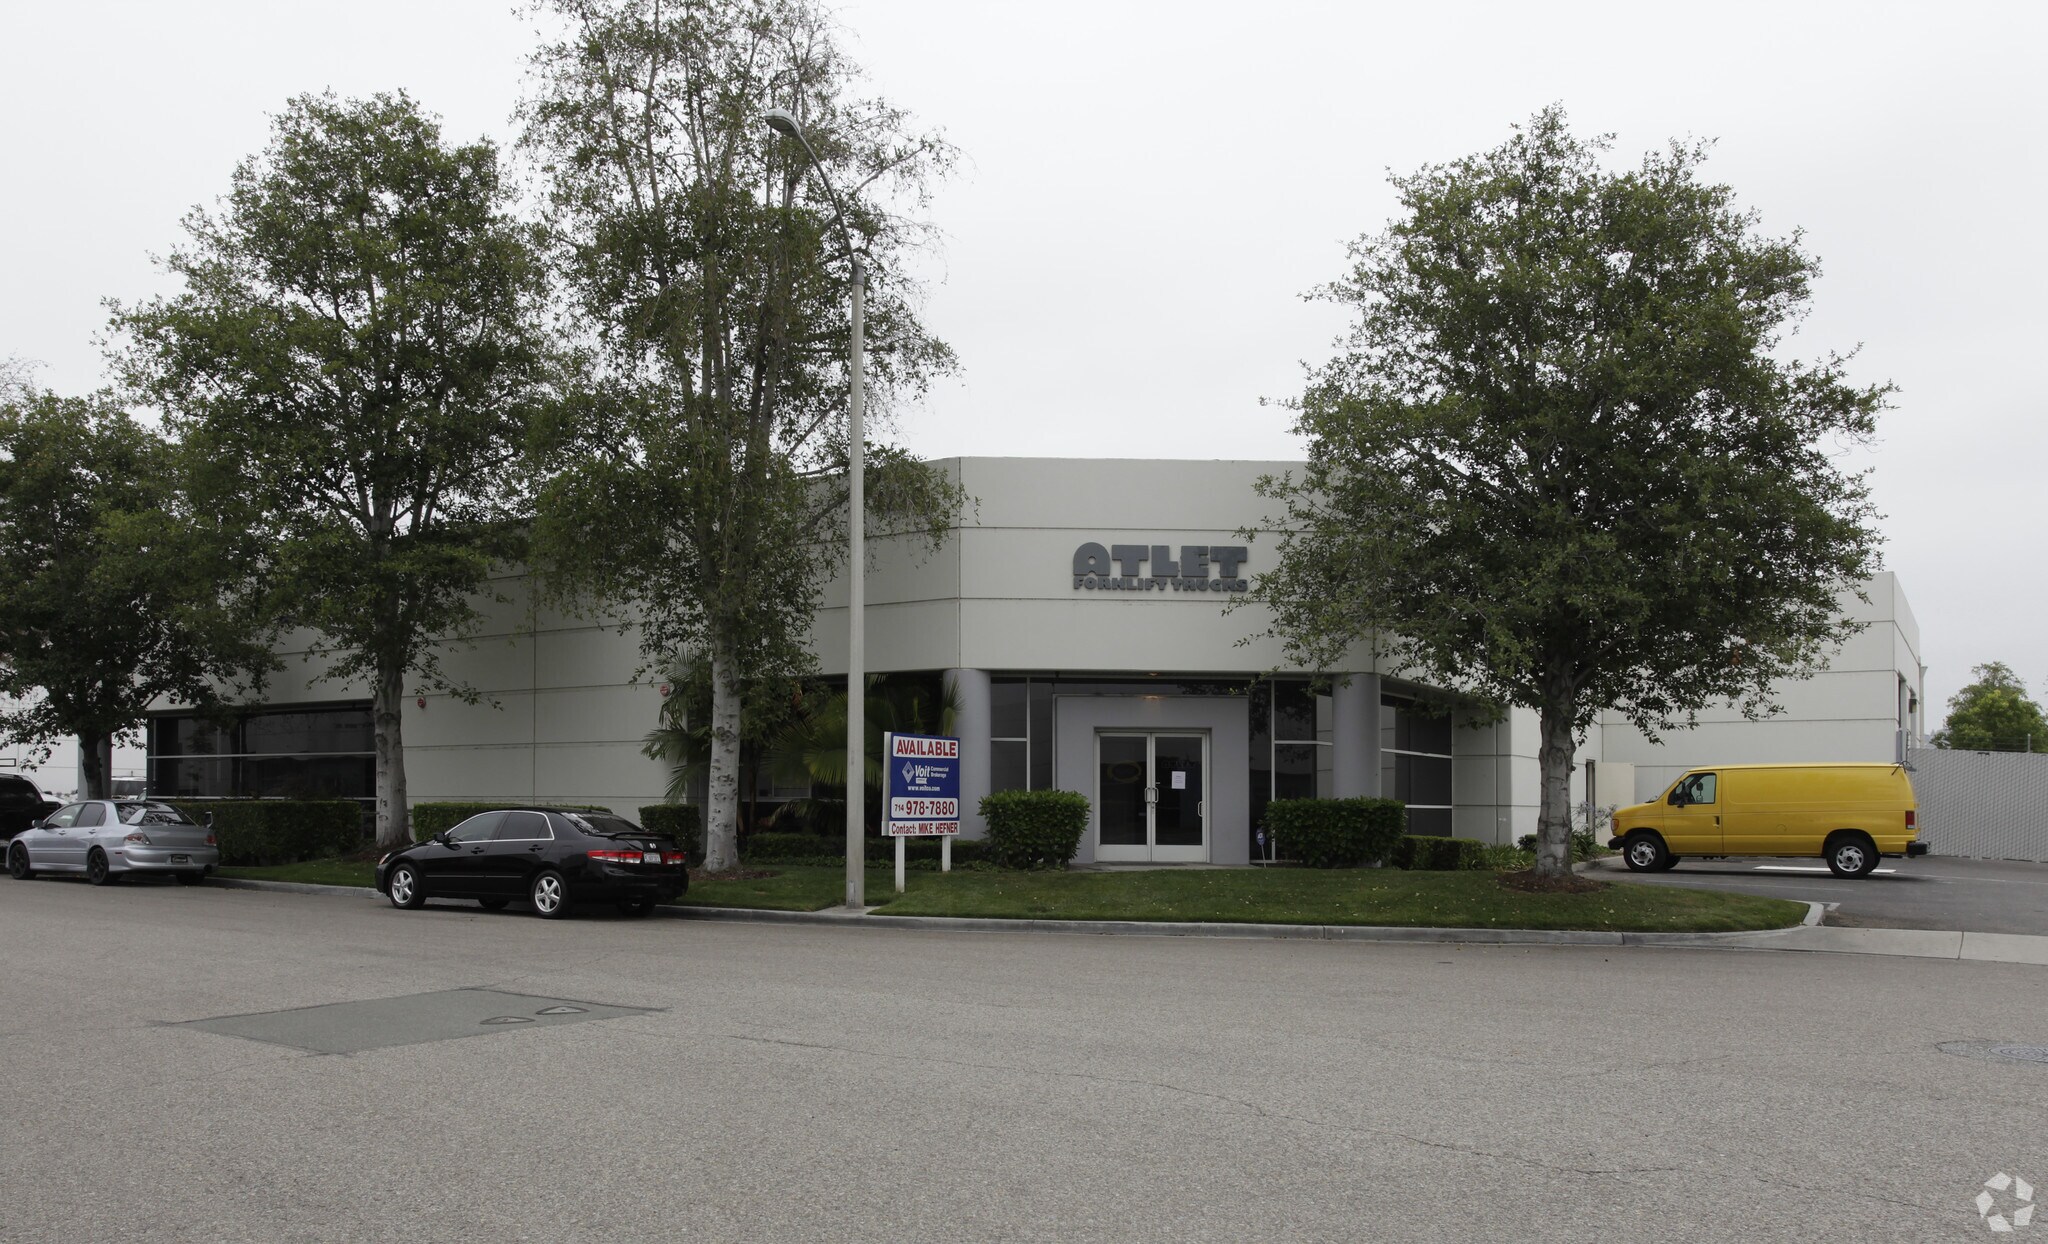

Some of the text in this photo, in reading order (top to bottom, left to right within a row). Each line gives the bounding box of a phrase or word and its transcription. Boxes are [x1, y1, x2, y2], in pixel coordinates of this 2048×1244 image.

[1073, 541, 1248, 577] ATLET
[1073, 577, 1248, 592] FORKLIFT TRUCKS
[896, 740, 956, 756] AVAILABLE
[915, 765, 930, 777] Voit
[895, 800, 955, 816] 714 978-7880
[891, 822, 958, 834] Contact: MIKE HEFNER
